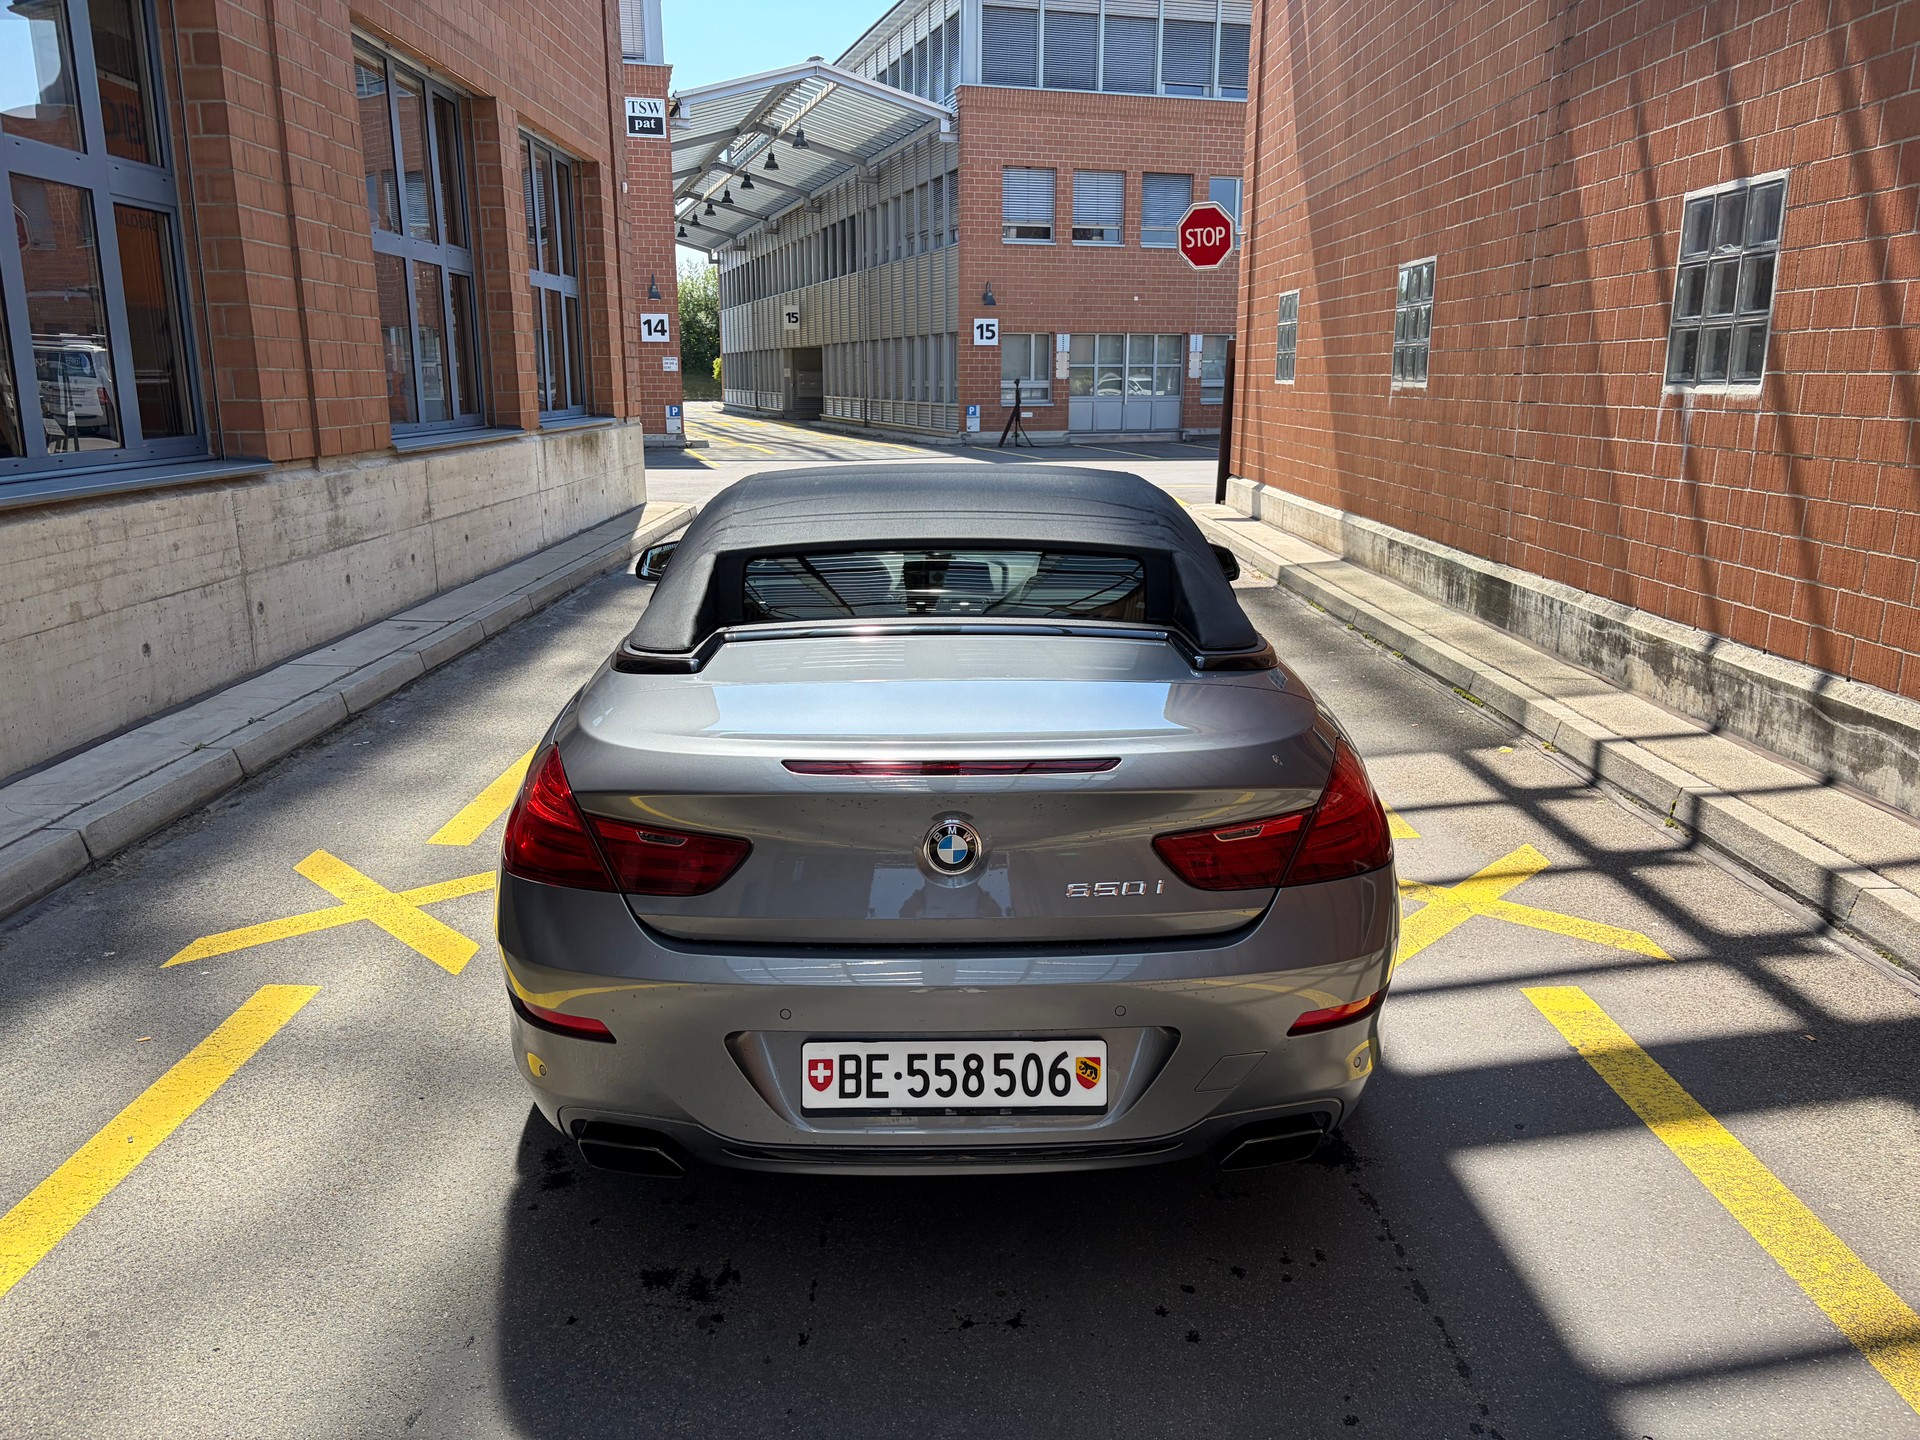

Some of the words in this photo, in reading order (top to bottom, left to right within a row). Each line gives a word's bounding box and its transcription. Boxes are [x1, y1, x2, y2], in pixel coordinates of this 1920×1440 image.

[628, 101, 662, 115] TSW
[634, 118, 656, 130] pat
[1185, 226, 1226, 248] STOP
[785, 312, 799, 323] 15
[642, 319, 667, 337] 14
[975, 323, 996, 340] 15
[672, 406, 679, 416] P
[969, 406, 975, 415] P
[932, 826, 973, 842] BMW
